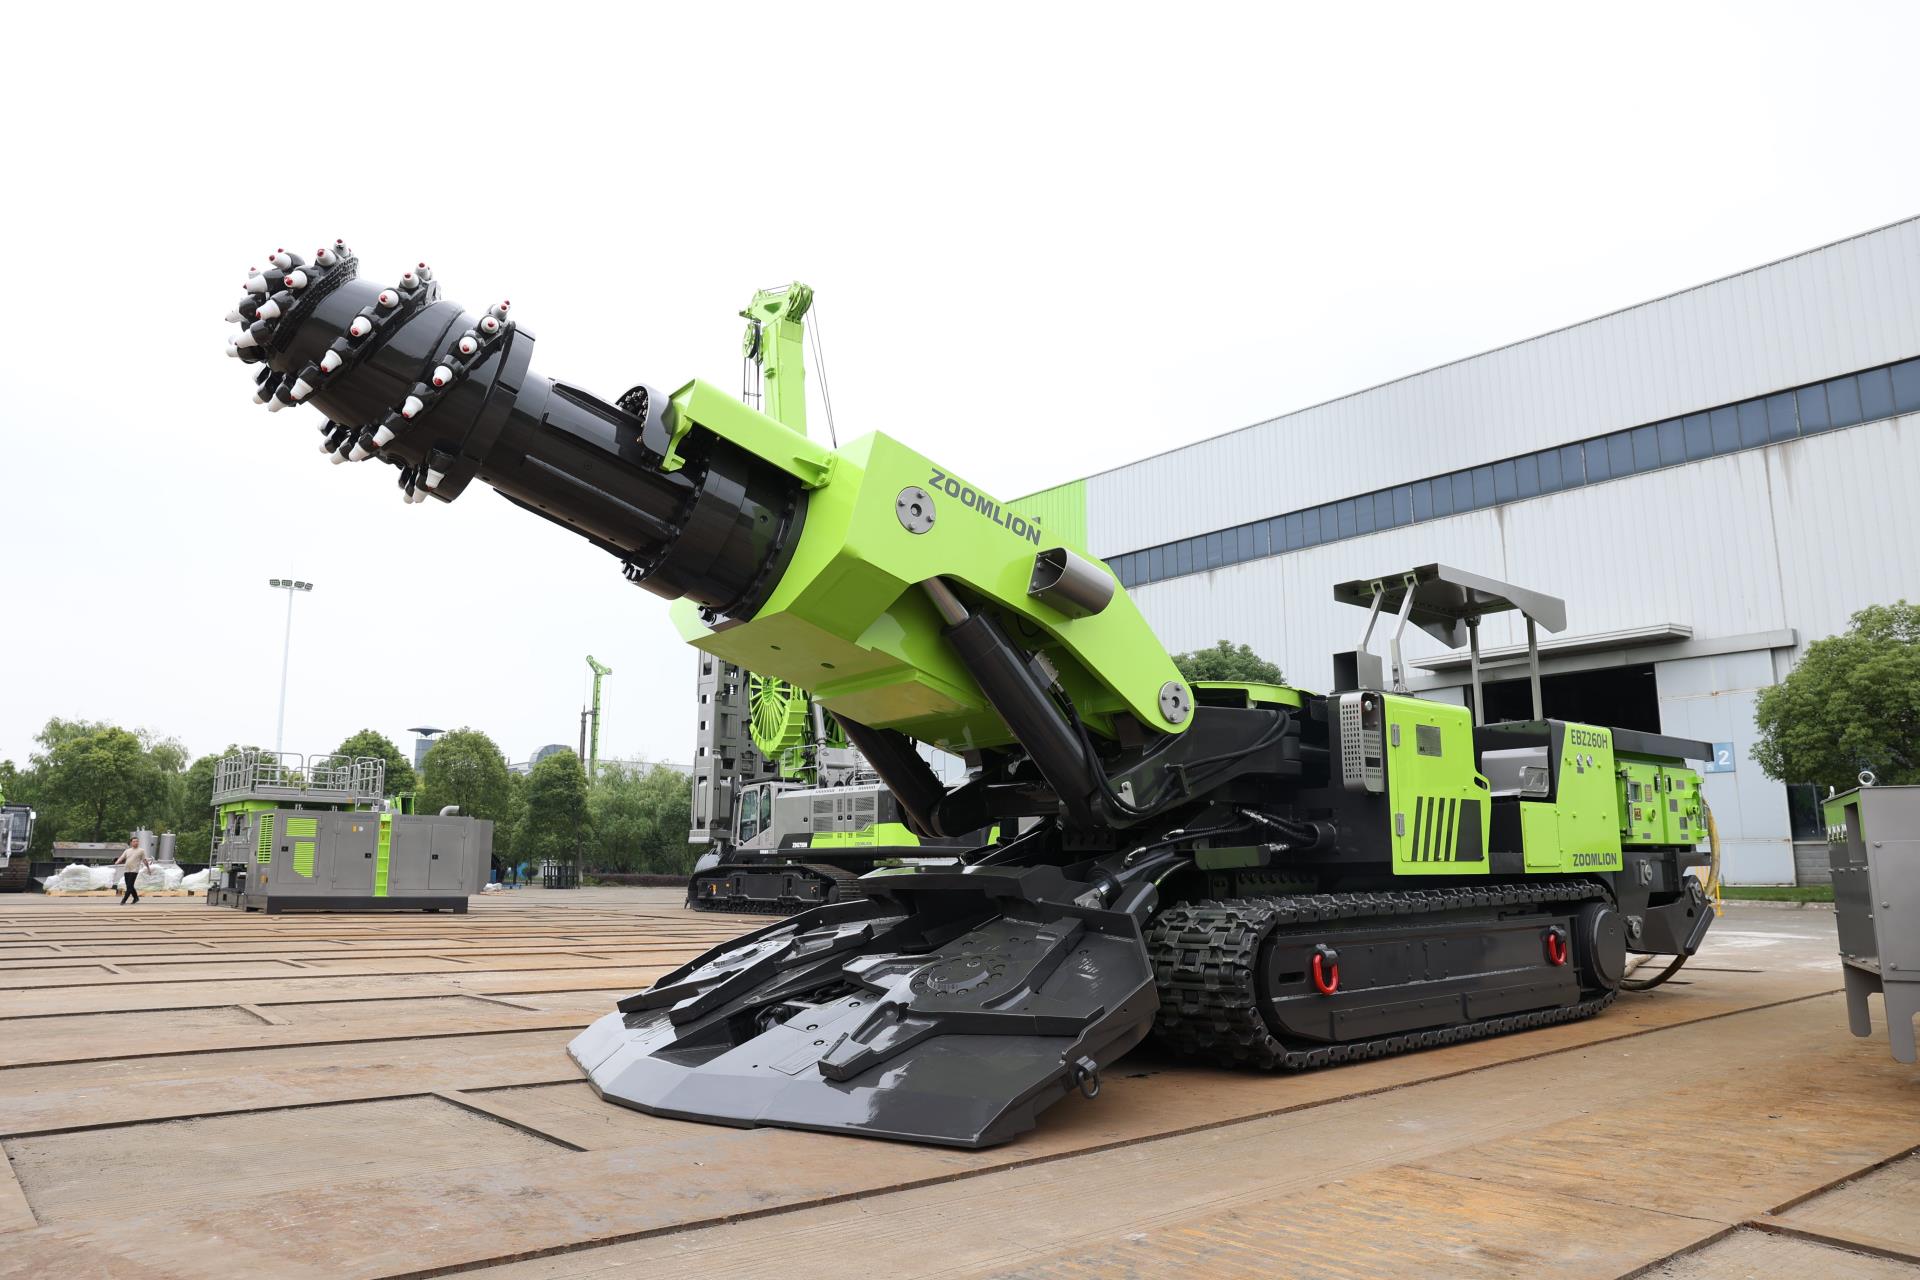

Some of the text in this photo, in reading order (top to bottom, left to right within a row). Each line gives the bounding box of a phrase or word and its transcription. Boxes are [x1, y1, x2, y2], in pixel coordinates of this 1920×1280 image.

[928, 467, 1041, 545] ZOOMLION
[1570, 729, 1608, 749] EBZ260H
[1718, 750, 1730, 765] 2
[1572, 853, 1617, 867] ZOOMLION
